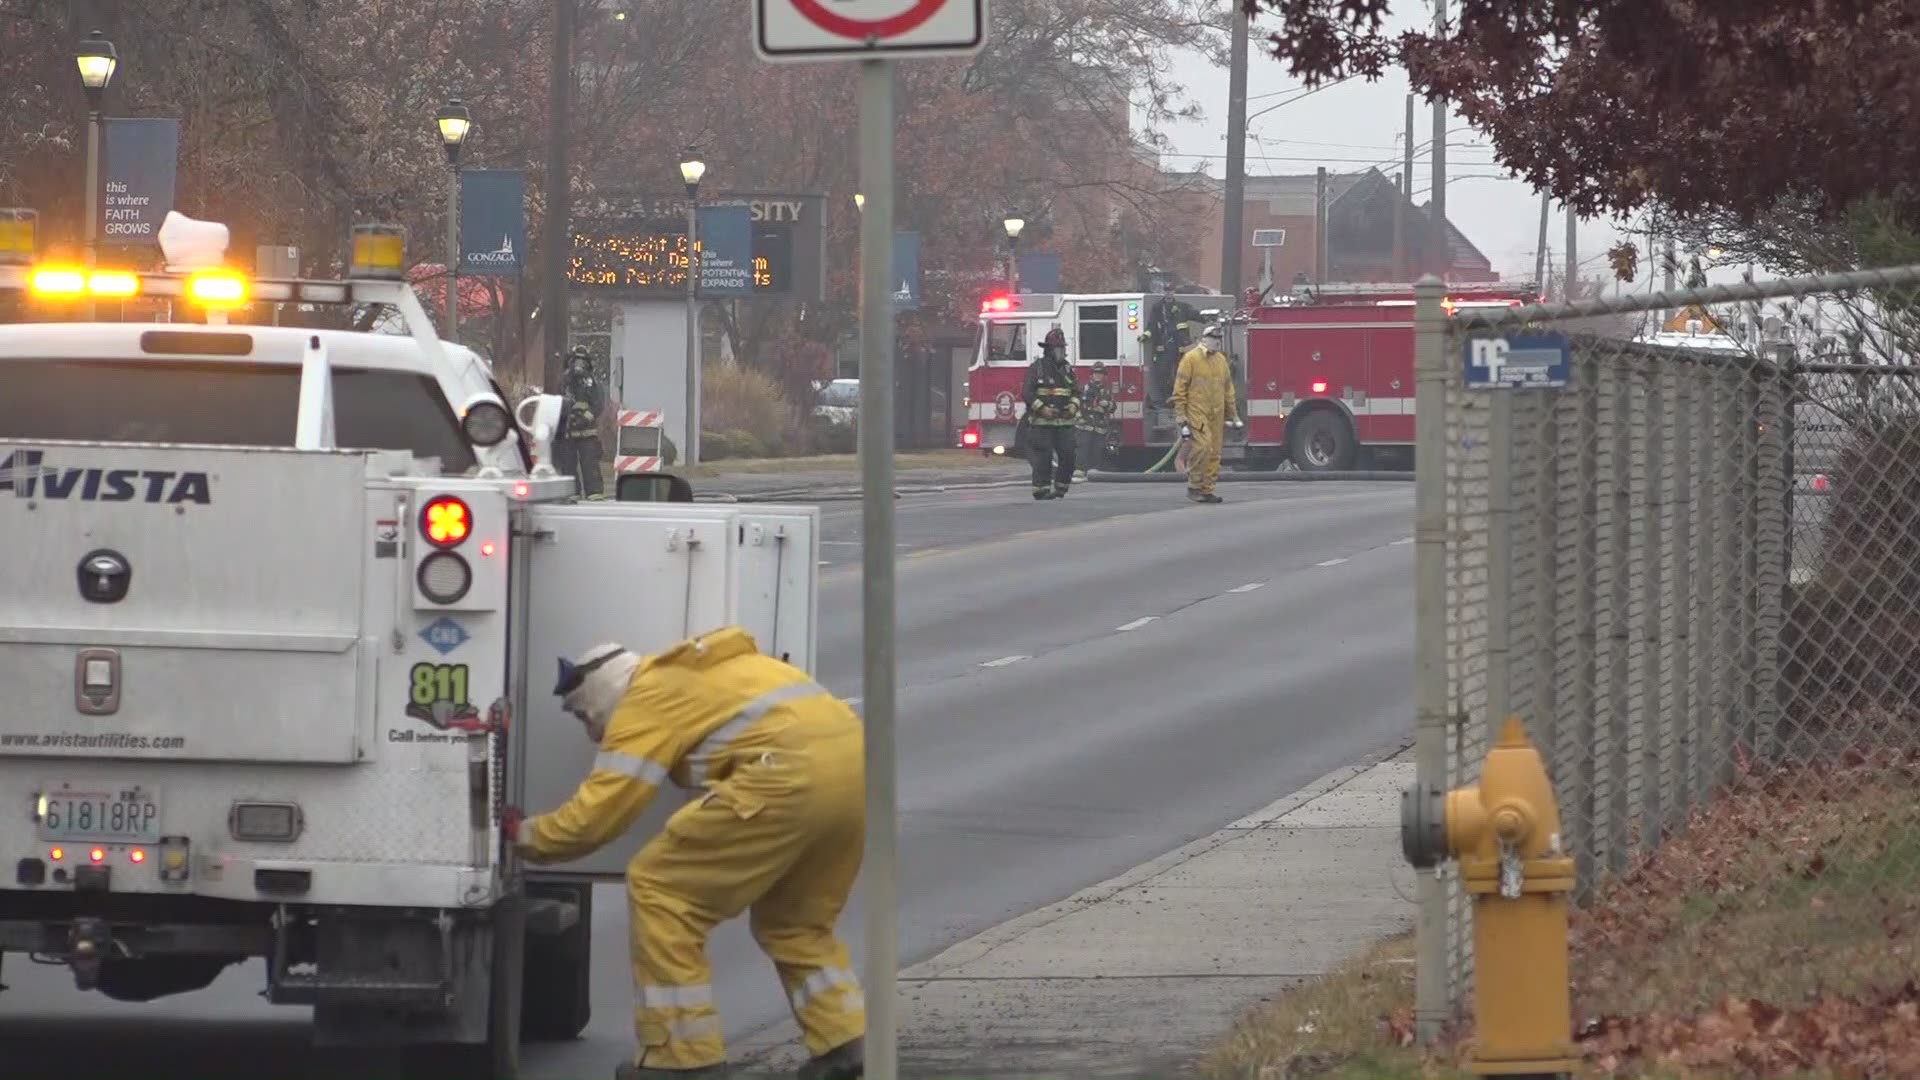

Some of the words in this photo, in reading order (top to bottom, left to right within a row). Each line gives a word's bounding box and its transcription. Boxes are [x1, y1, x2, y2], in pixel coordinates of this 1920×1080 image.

[106, 182, 127, 193] this
[106, 195, 114, 205] is
[117, 194, 149, 205] where
[105, 209, 139, 220] FAITH
[105, 223, 150, 234] GROWS
[467, 253, 516, 262] GONZAGA
[701, 250, 717, 258] this
[710, 259, 733, 267] where
[701, 269, 752, 278] POTENTIAL
[701, 278, 745, 288] EXPANDS
[0, 449, 211, 505] AVISTA
[411, 662, 469, 706] 811
[388, 728, 414, 743] Call
[416, 732, 449, 743] before
[0, 734, 185, 749] www.avistautilities.com
